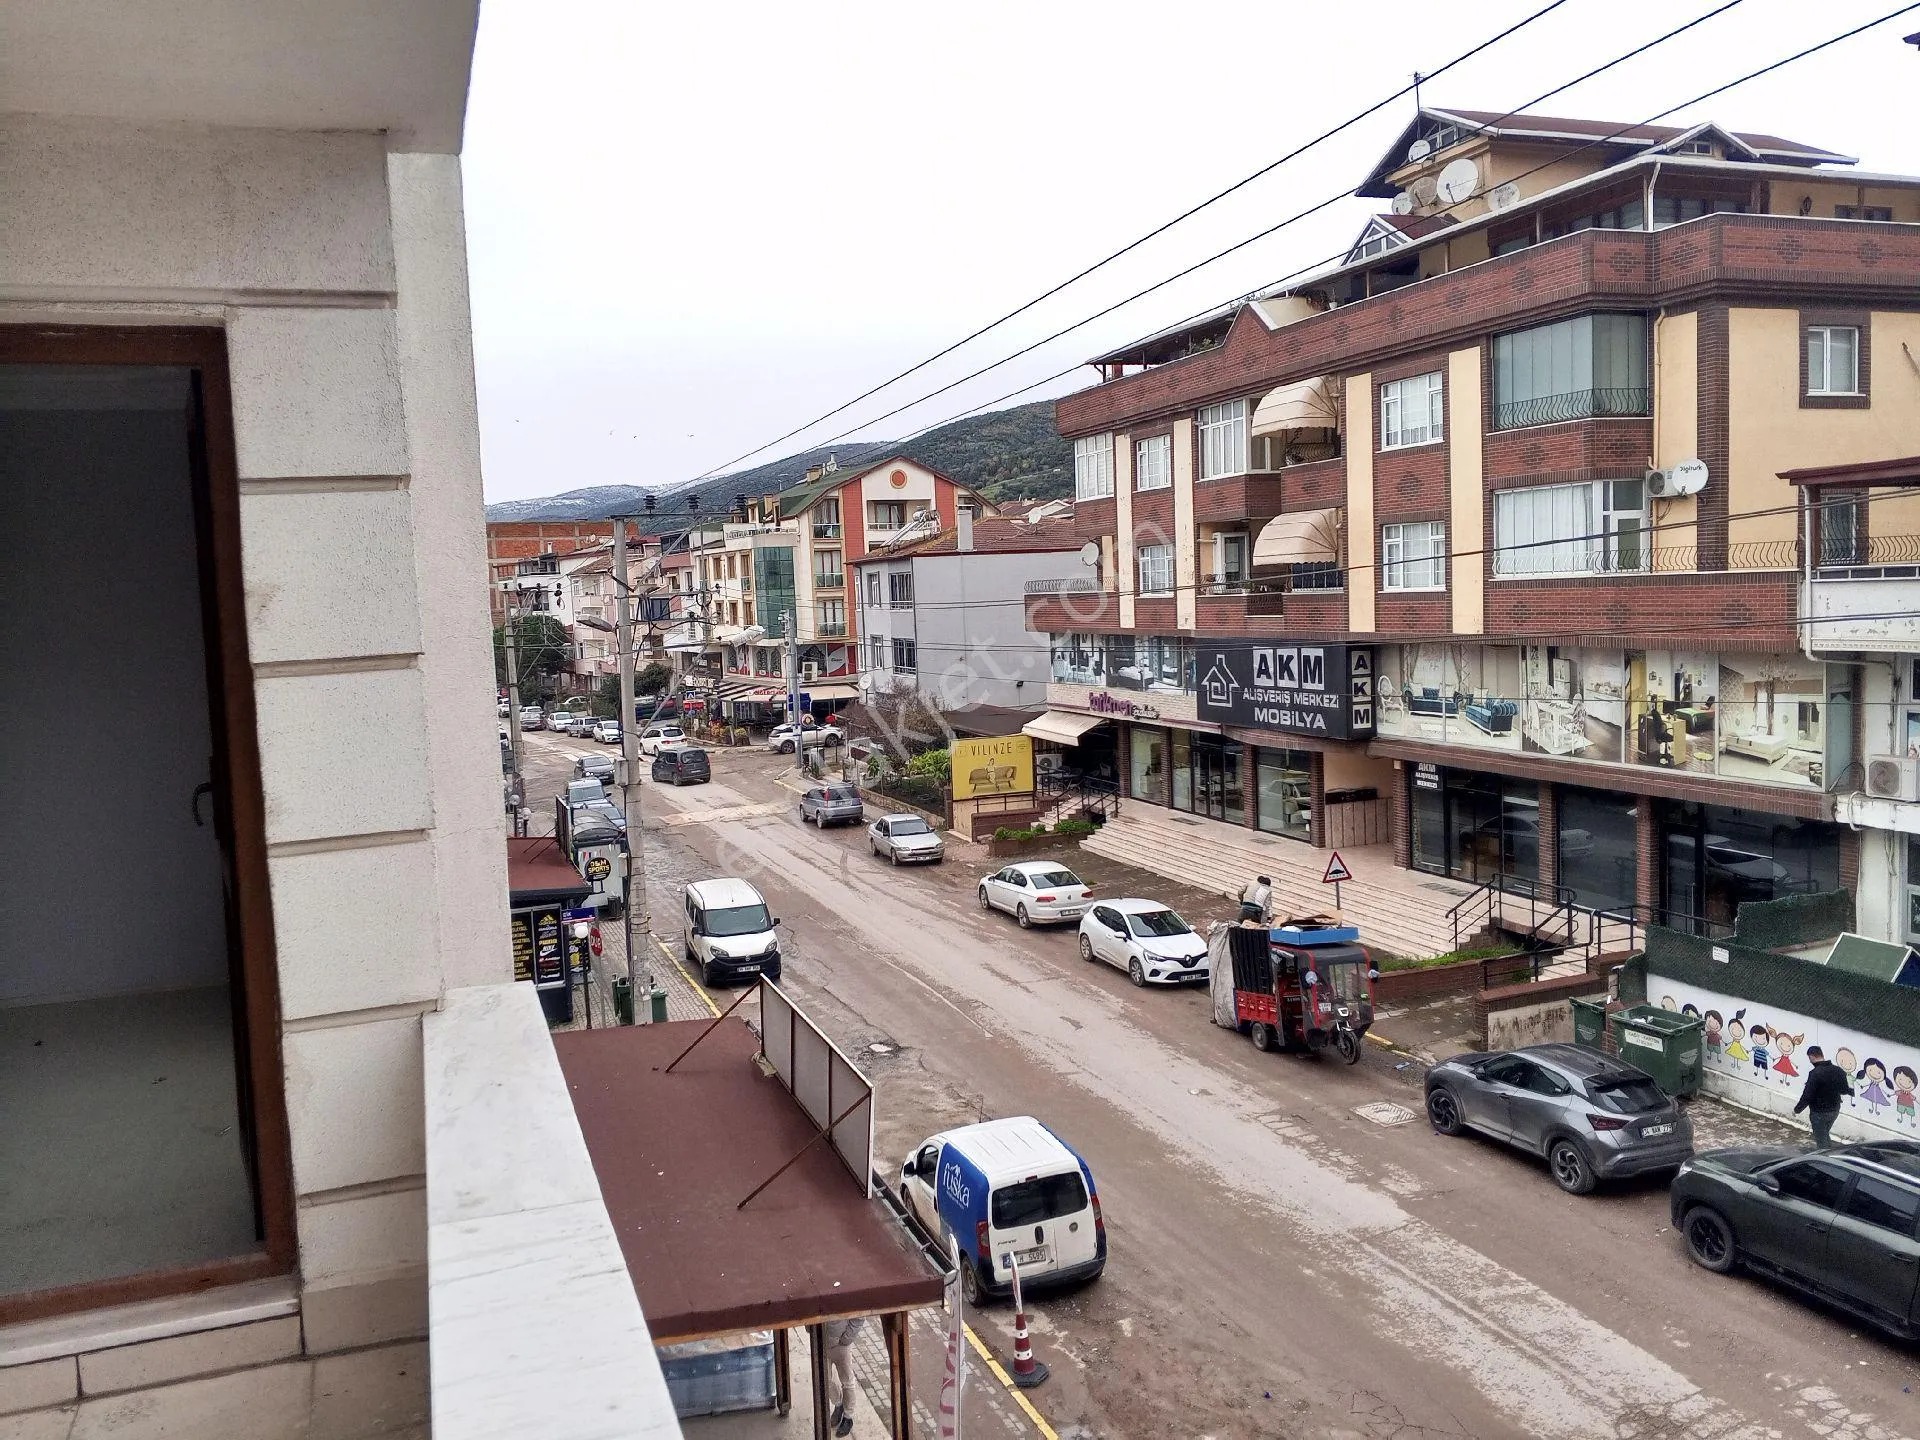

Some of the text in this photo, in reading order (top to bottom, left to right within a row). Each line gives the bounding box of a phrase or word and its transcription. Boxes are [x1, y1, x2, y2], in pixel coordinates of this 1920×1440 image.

[1255, 652, 1323, 686] AKM
[1353, 653, 1370, 725] AKM
[588, 865, 609, 873] SPORTS
